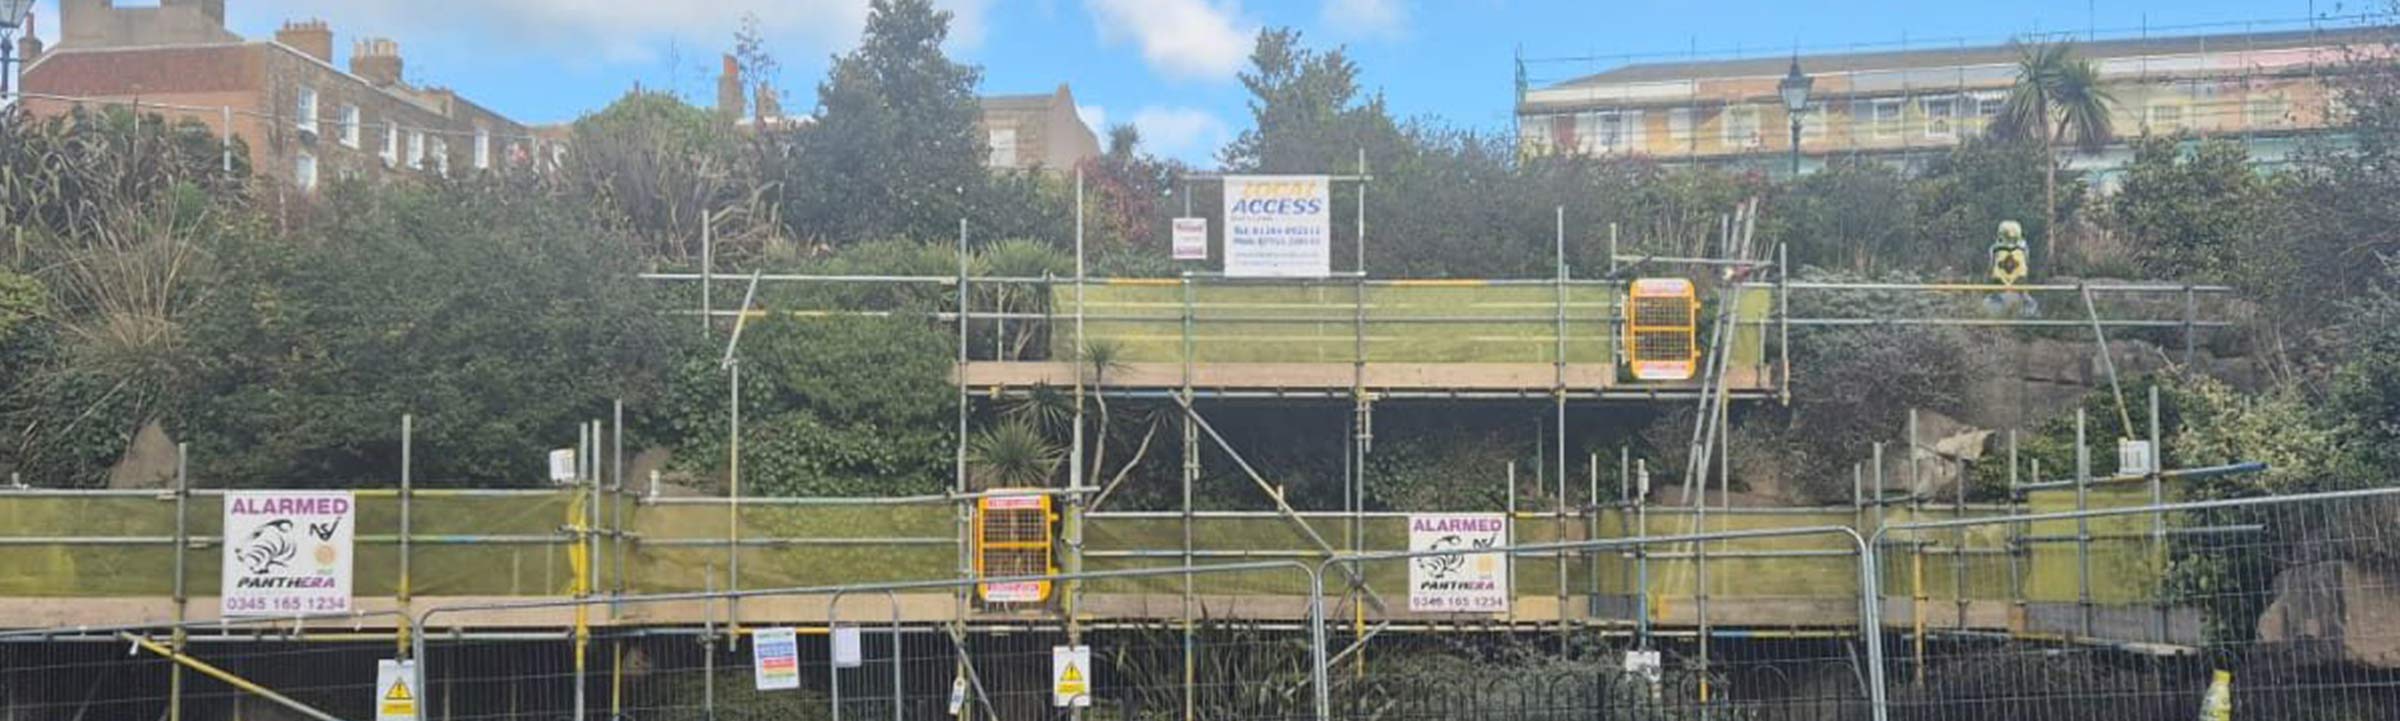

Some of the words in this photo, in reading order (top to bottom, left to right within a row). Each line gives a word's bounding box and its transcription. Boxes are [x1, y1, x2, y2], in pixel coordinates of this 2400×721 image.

[1230, 198, 1322, 215] ACCESS
[231, 497, 349, 515] ALARMED
[1413, 518, 1503, 532] ALARMED
[237, 576, 336, 588] PANTHERA
[1420, 580, 1495, 590] PANTHERA
[227, 597, 266, 610] 0345
[273, 597, 301, 610] 165
[308, 597, 345, 610] 1234
